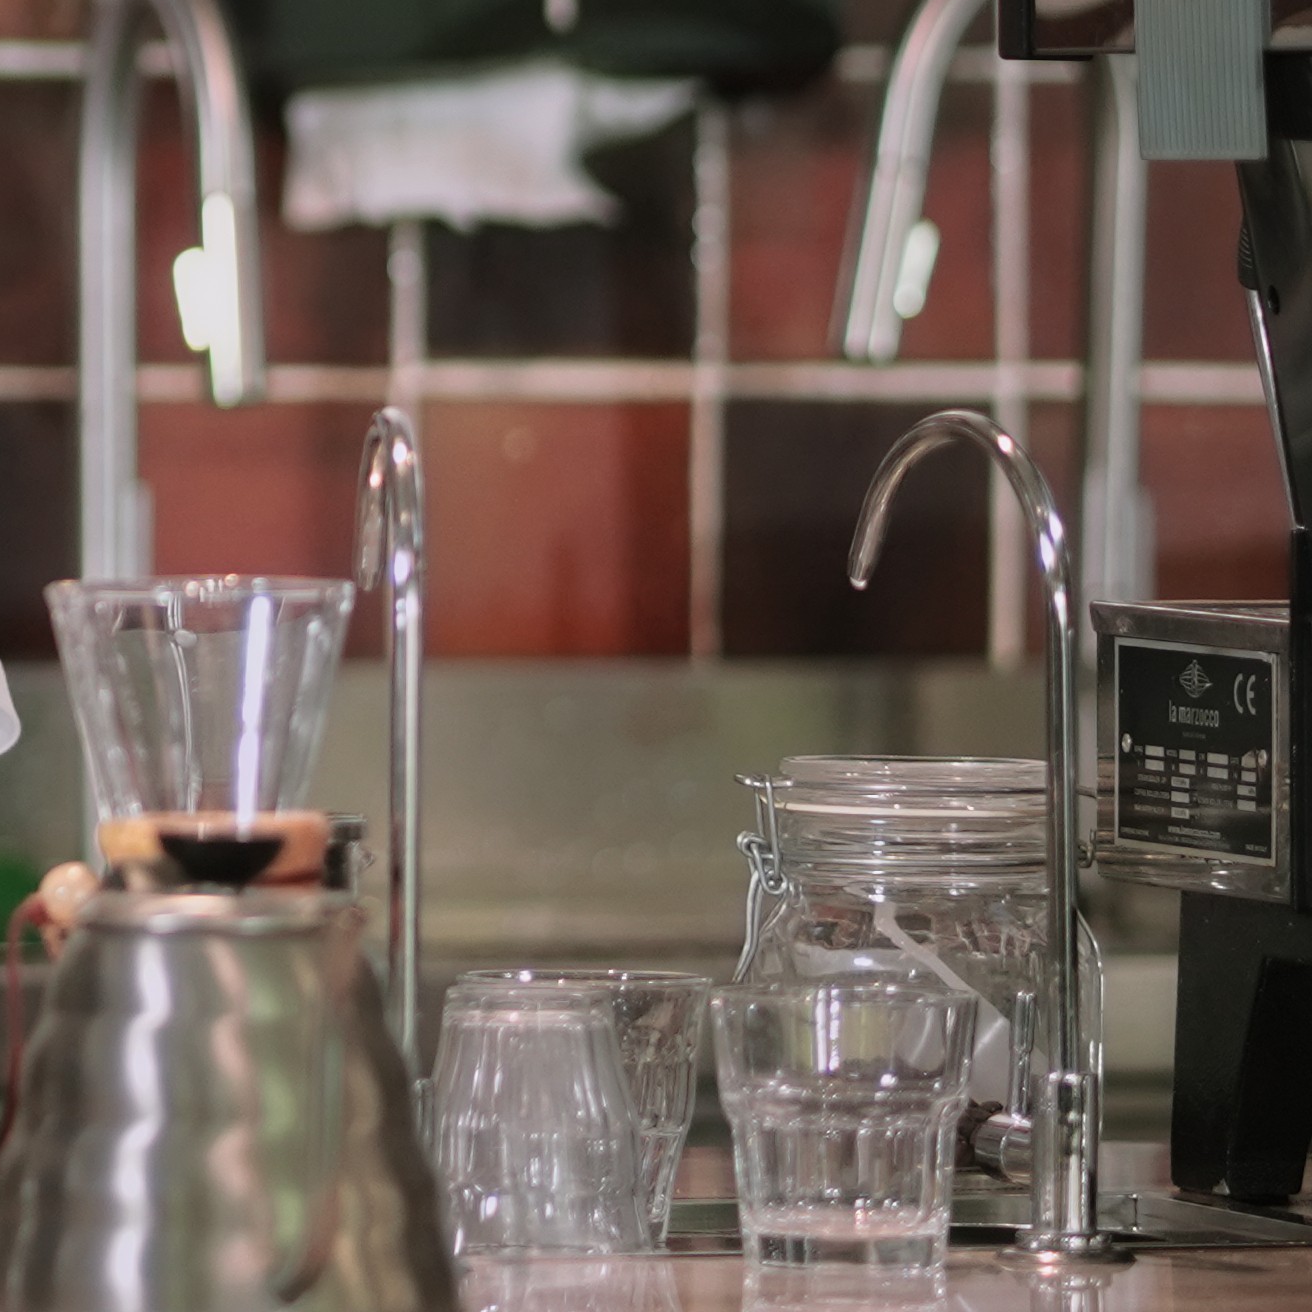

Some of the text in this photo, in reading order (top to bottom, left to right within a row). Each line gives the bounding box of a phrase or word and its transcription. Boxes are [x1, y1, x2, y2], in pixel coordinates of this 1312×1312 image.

[1233, 672, 1257, 715] CE
[1168, 700, 1220, 728] la marzocco
